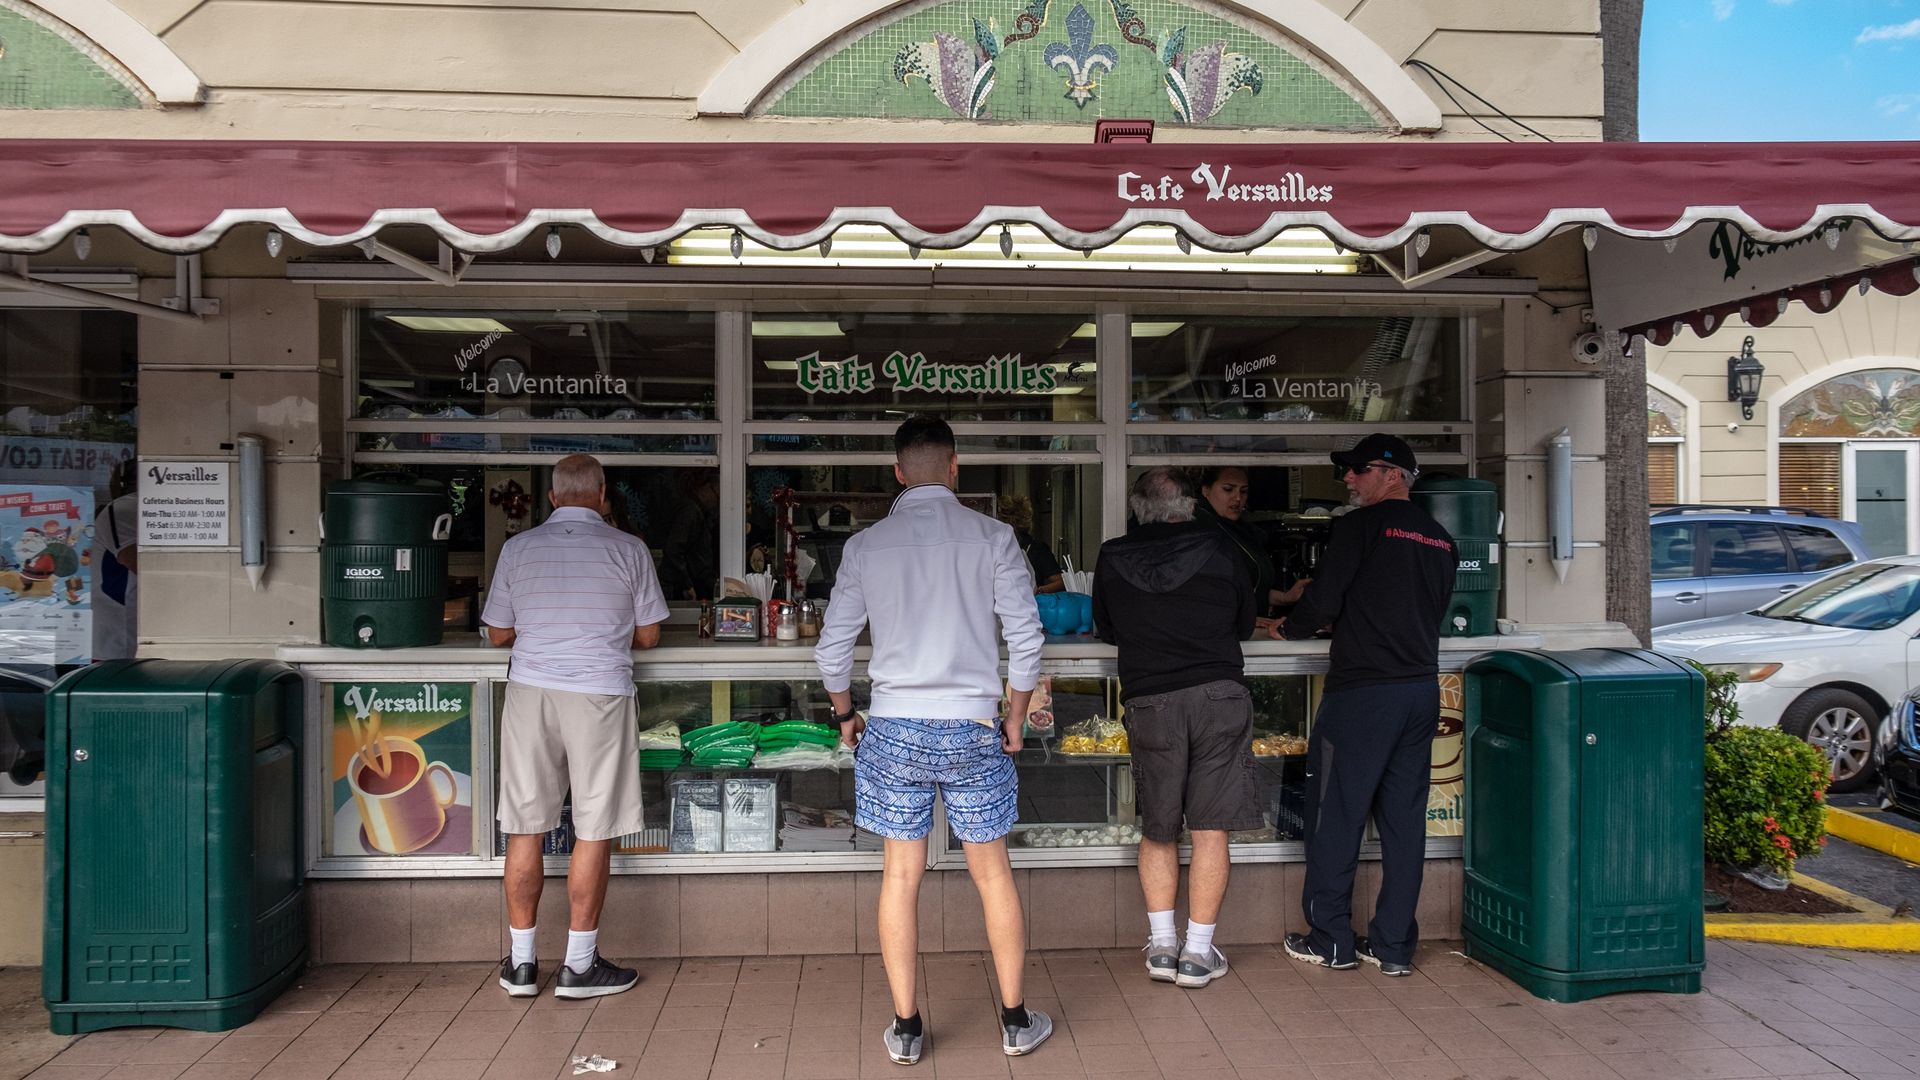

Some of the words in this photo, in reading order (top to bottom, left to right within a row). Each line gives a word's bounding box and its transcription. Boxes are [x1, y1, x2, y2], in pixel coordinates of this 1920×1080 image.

[1118, 172, 1184, 202] Cafe
[1191, 162, 1333, 202] Versailles
[454, 328, 502, 372] Welcome
[796, 351, 875, 394] Cafe
[882, 350, 1057, 394] Versailles
[1225, 354, 1277, 382] Welcome
[473, 372, 500, 394] La
[506, 371, 627, 394] Ventanita
[1242, 378, 1266, 398] La
[1273, 376, 1382, 398] Ventanita
[148, 466, 218, 485] Versailles
[143, 497, 174, 505] Cafeteria
[175, 497, 204, 505] Business
[206, 497, 225, 505] Hours
[142, 510, 172, 518] Mon-Thu
[173, 510, 186, 518] 6:30
[202, 510, 215, 518] 1:00
[216, 510, 226, 518] AM
[146, 521, 169, 529] Fri-Sat
[170, 521, 183, 529] 6:30
[211, 521, 222, 529] AM
[149, 532, 163, 540] Sun
[178, 532, 188, 540] AM
[194, 532, 208, 540] 1:00
[208, 532, 219, 540] AM
[346, 568, 382, 576] IGLOO
[344, 683, 462, 719] Versailles
